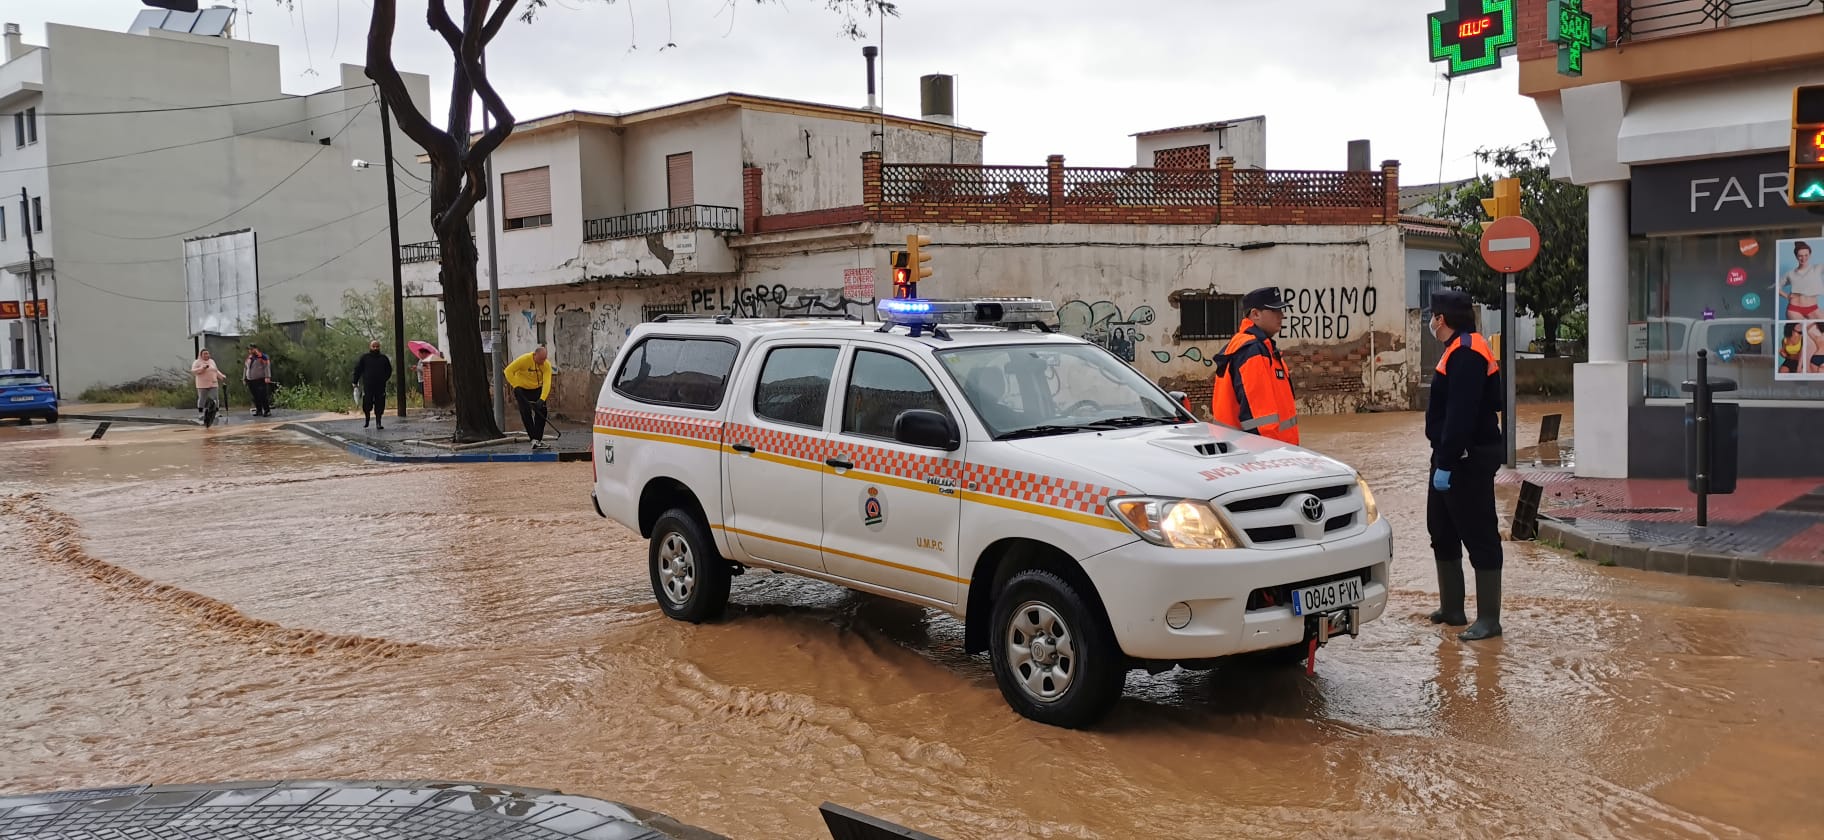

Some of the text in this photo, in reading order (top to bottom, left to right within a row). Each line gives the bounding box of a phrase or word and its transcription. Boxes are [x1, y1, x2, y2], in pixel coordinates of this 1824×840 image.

[1281, 286, 1376, 316] ROXIMO
[1278, 314, 1349, 339] ERRIBO
[1305, 580, 1360, 610] 0049 FVX
